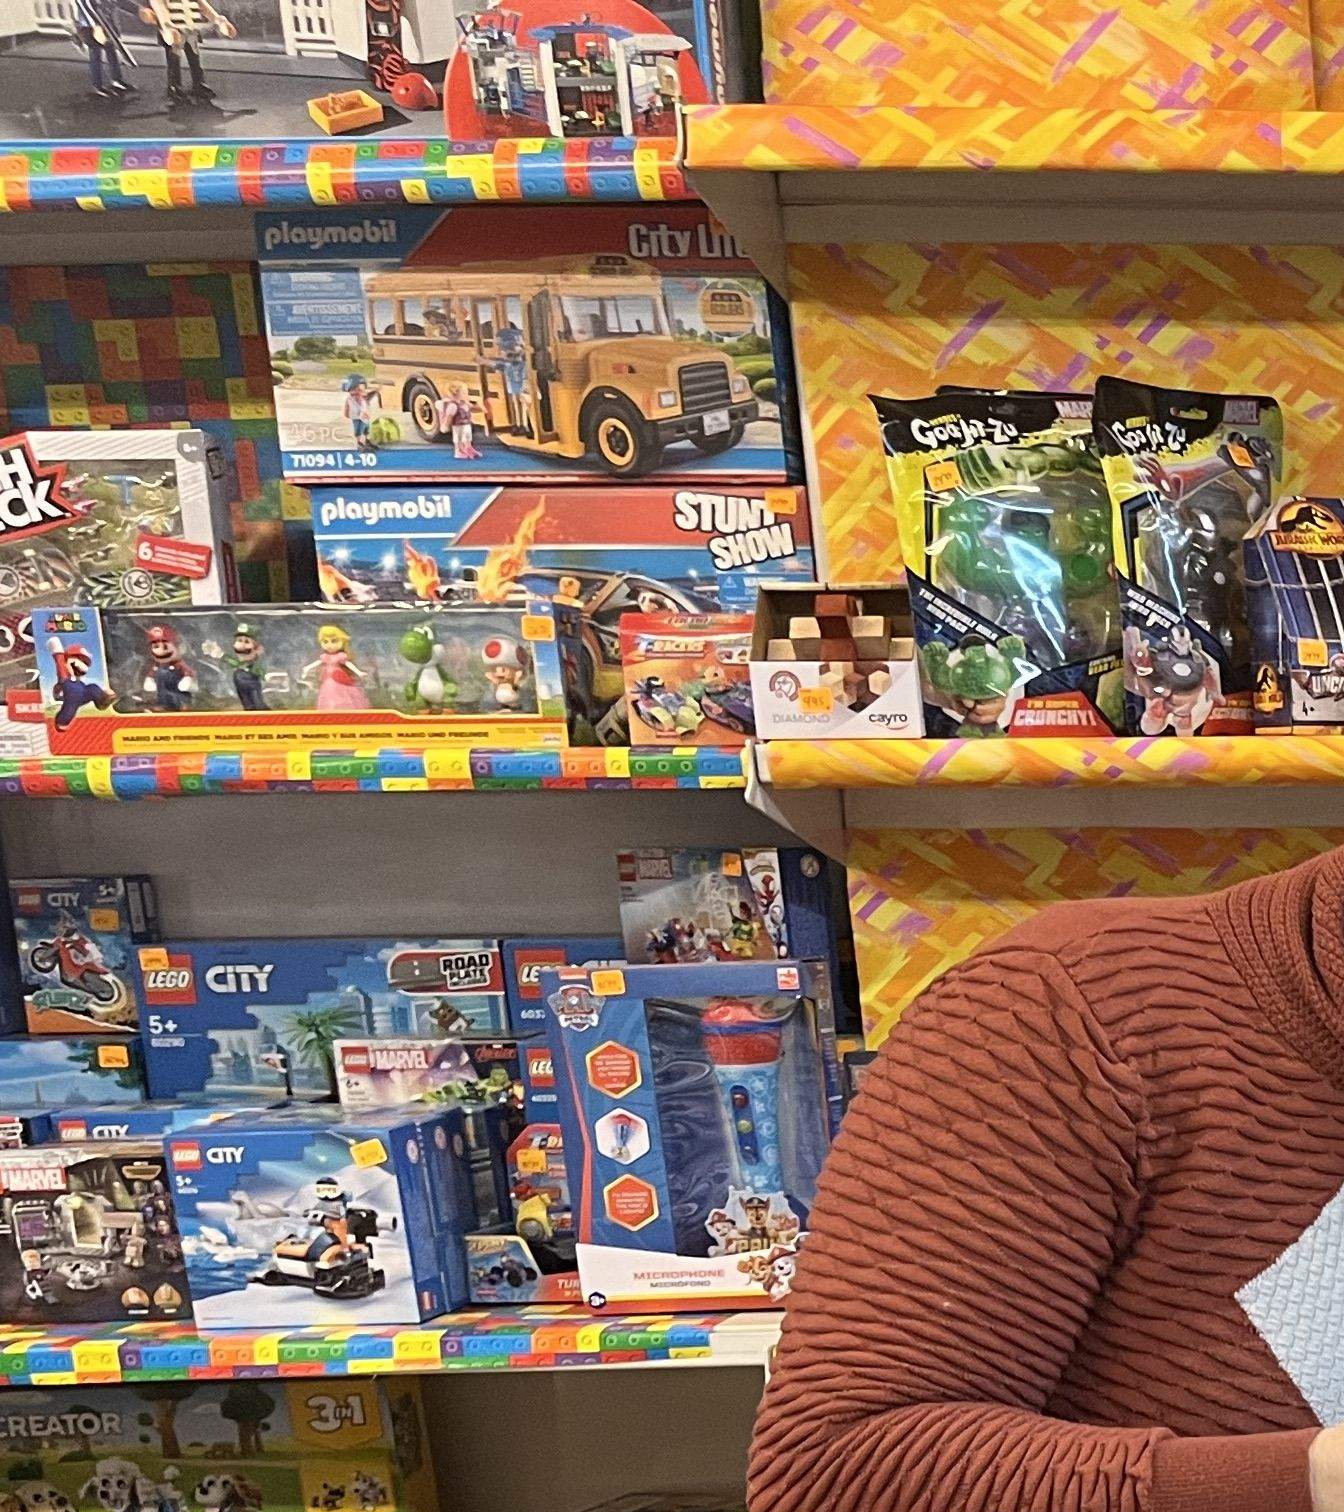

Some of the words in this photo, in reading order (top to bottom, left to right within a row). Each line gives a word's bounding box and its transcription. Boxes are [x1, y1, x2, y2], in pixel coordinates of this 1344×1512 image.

[264, 219, 397, 250] playmobil
[627, 224, 692, 259] City
[321, 495, 452, 526] playmobil
[673, 491, 777, 535] STUNT
[714, 523, 796, 571] SHOW
[868, 712, 908, 726] cayro
[441, 953, 490, 973] ROAD
[147, 968, 190, 991] LEGO
[205, 964, 274, 993] CITY
[149, 1015, 178, 1034] 5+
[206, 1146, 245, 1164] CITY
[0, 1411, 123, 1439] CREATOR
